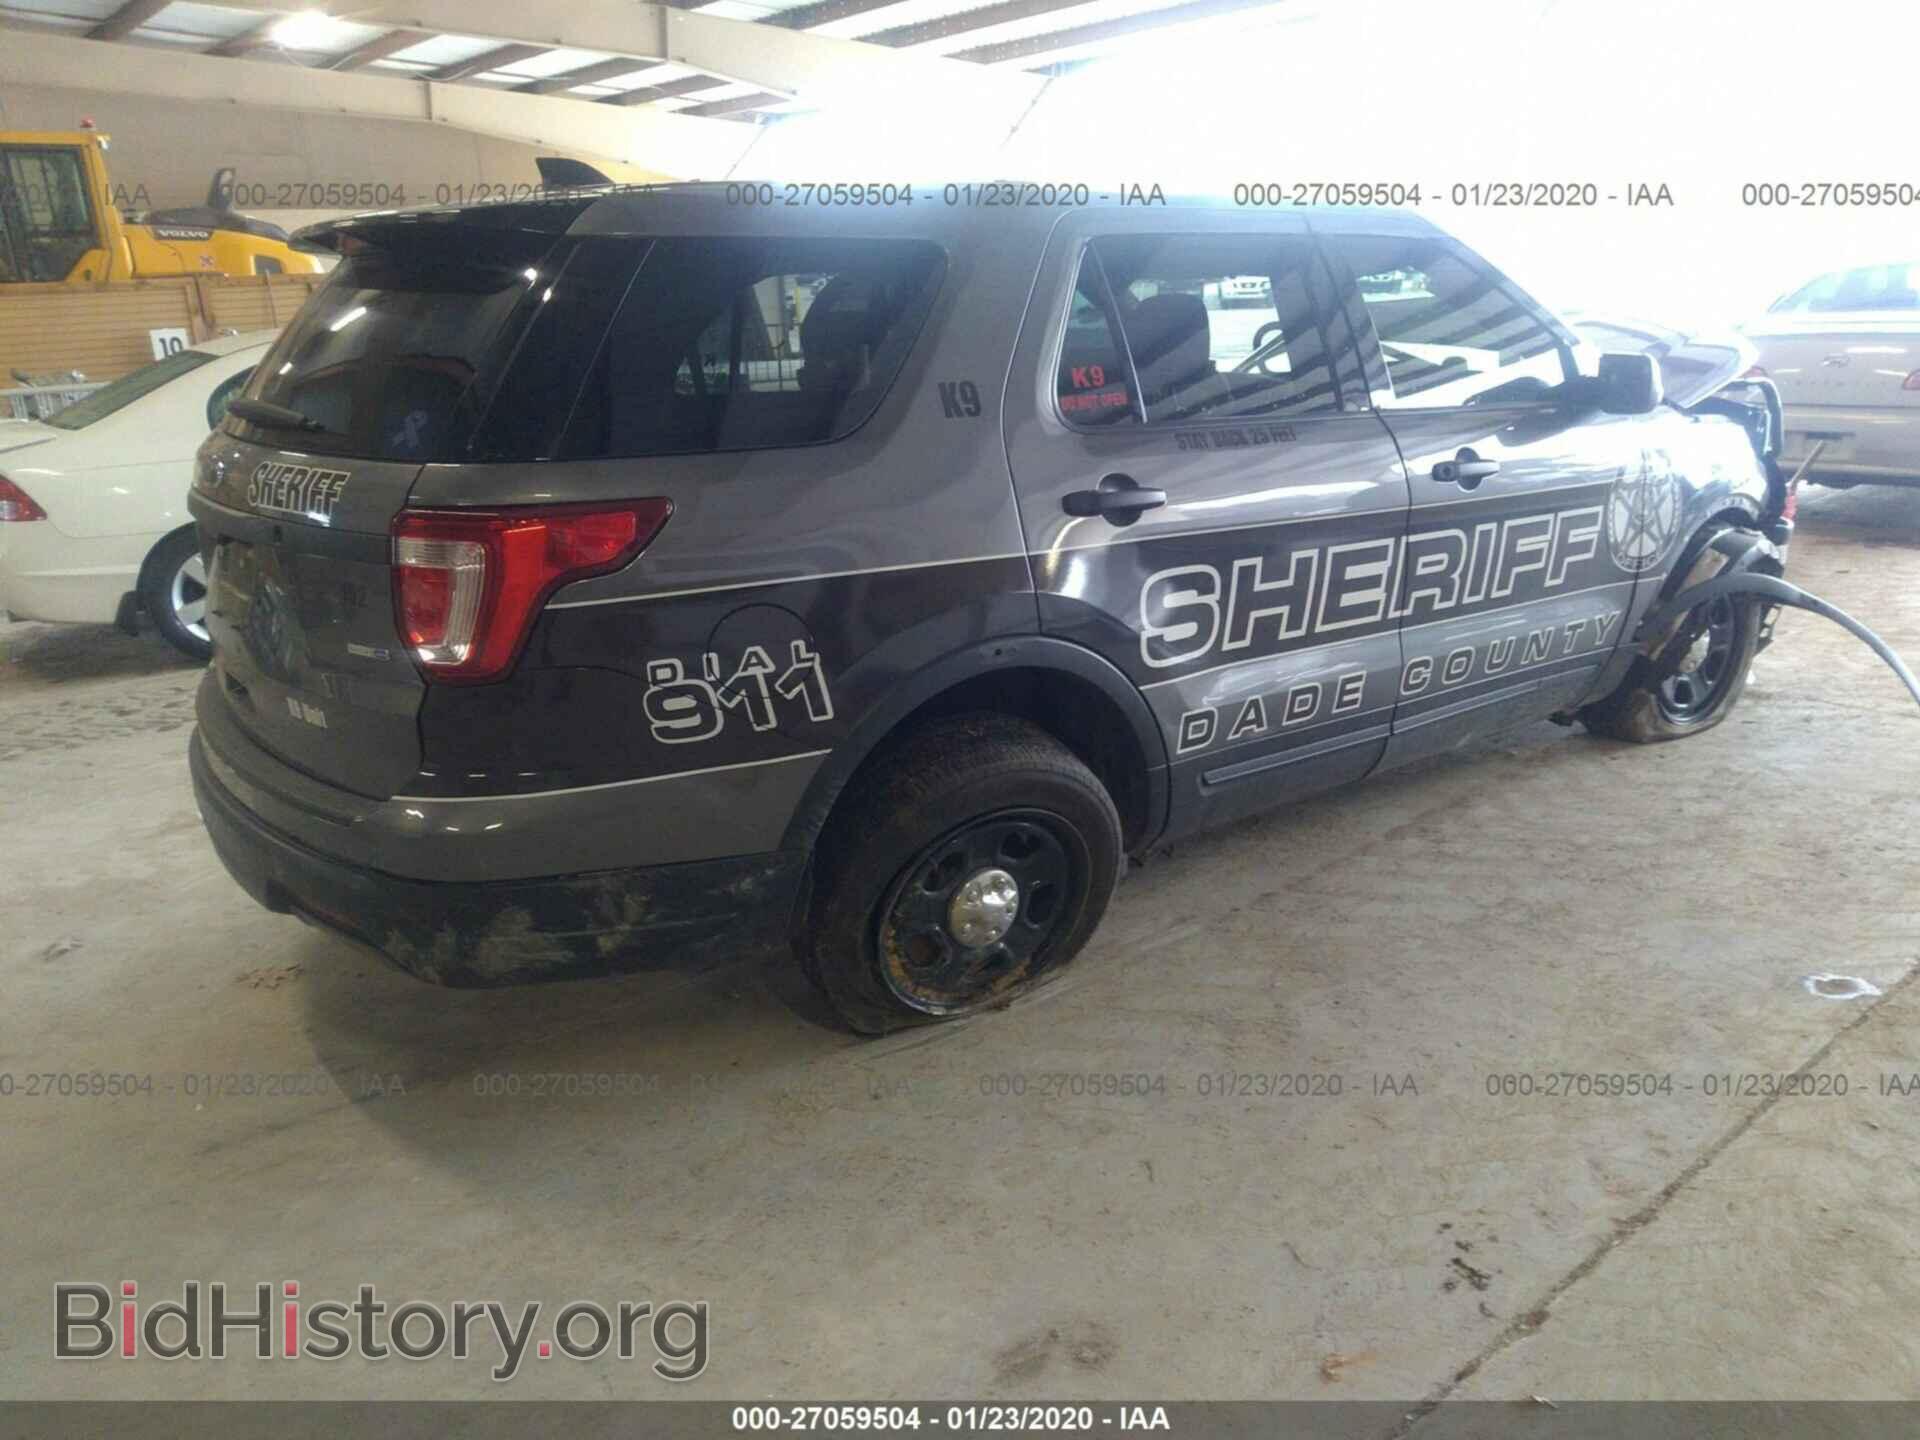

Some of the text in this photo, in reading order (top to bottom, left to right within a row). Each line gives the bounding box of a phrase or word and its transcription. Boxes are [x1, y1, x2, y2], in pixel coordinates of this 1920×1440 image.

[159, 230, 208, 238] VOLVO
[938, 381, 982, 419] K9
[1071, 365, 1105, 388] K9
[248, 461, 351, 520] SHERIFF
[1140, 505, 1604, 668] SHERIFF
[647, 639, 821, 689] DIAL
[1176, 611, 1621, 754] DADE COUNTY
[643, 662, 835, 744] 911
